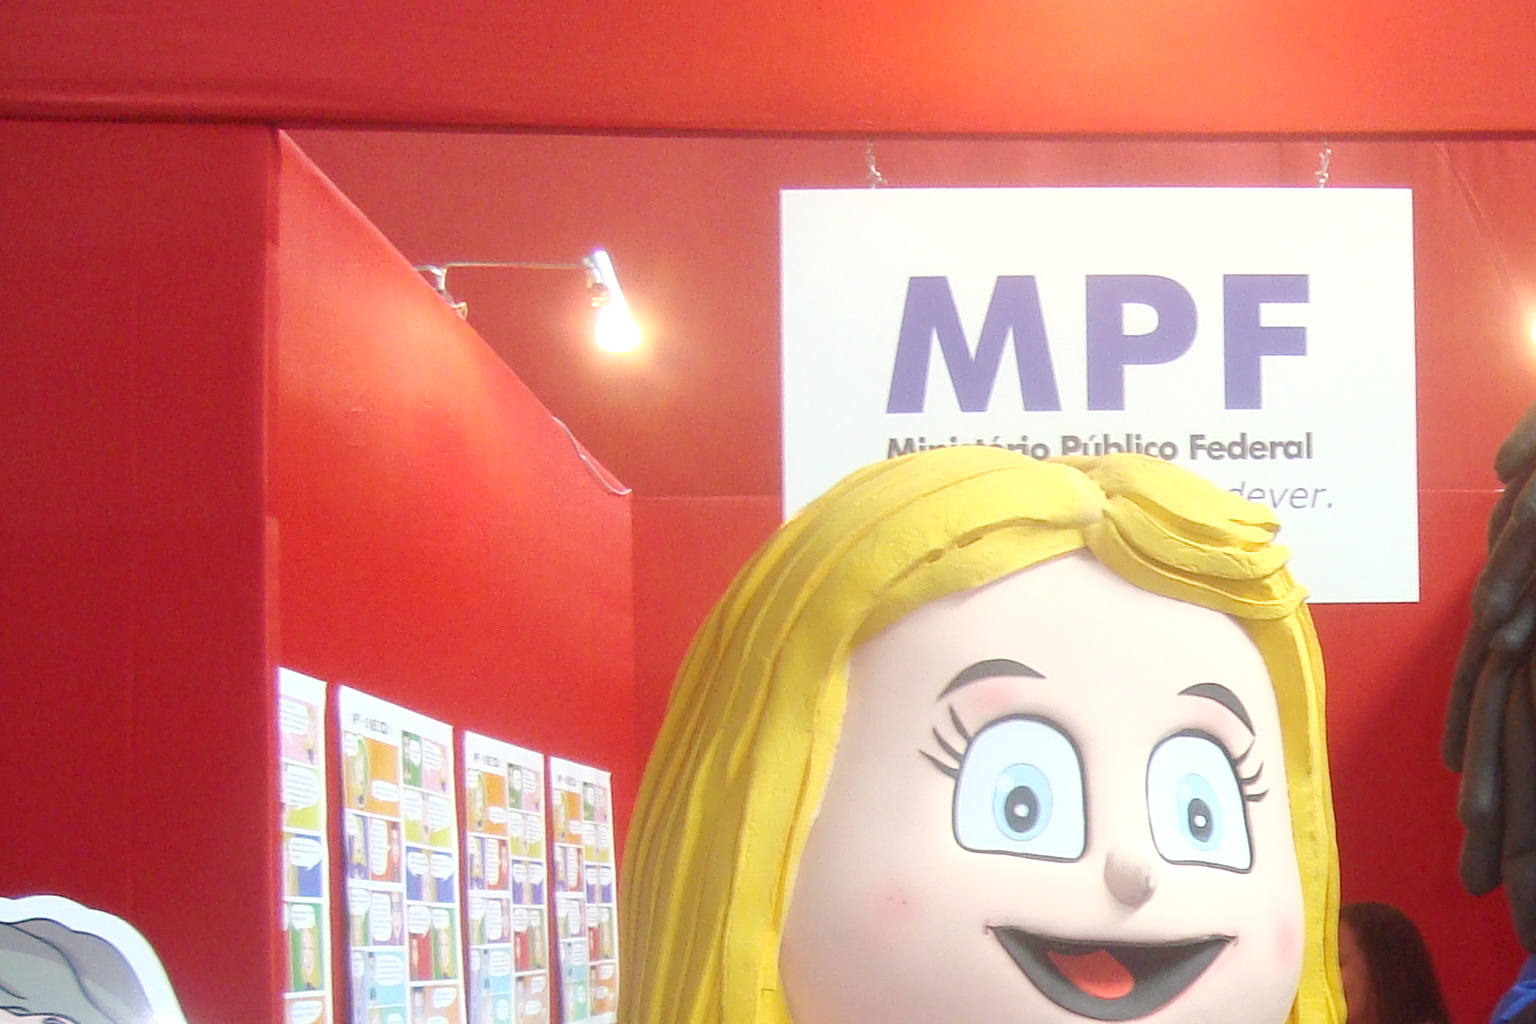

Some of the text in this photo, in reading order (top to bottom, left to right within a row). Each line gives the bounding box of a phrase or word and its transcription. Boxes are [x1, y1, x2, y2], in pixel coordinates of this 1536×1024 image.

[886, 273, 1311, 414] MPF
[886, 432, 1313, 461] Mirio Público Federal
[1229, 481, 1333, 510] dever.
